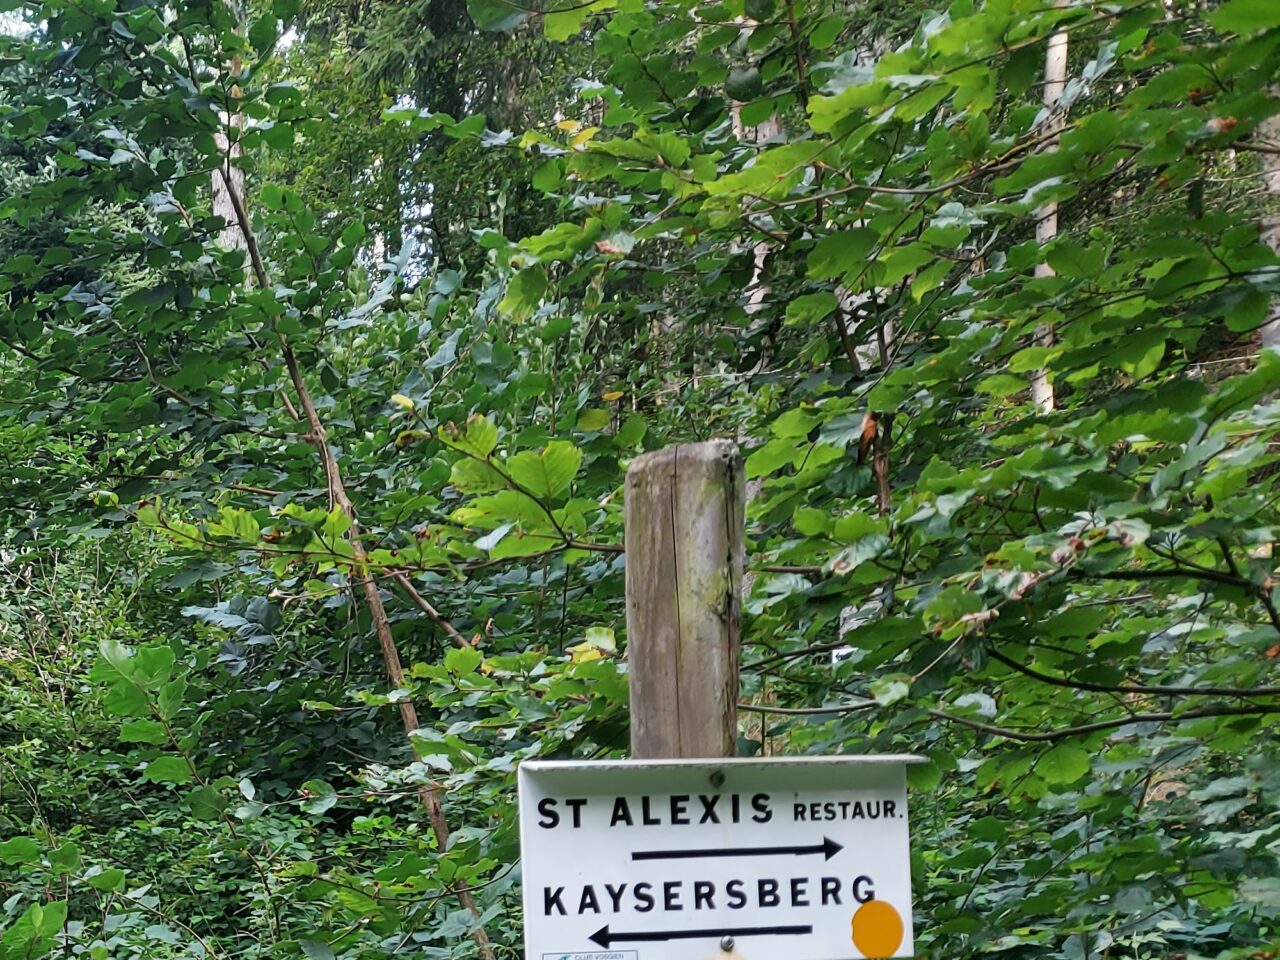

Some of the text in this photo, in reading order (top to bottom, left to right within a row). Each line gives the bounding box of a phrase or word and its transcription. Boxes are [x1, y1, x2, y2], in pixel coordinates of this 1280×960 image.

[537, 793, 904, 829] ST ALEXIS RESTAUR.
[543, 875, 876, 916] KAYSERSBERG
